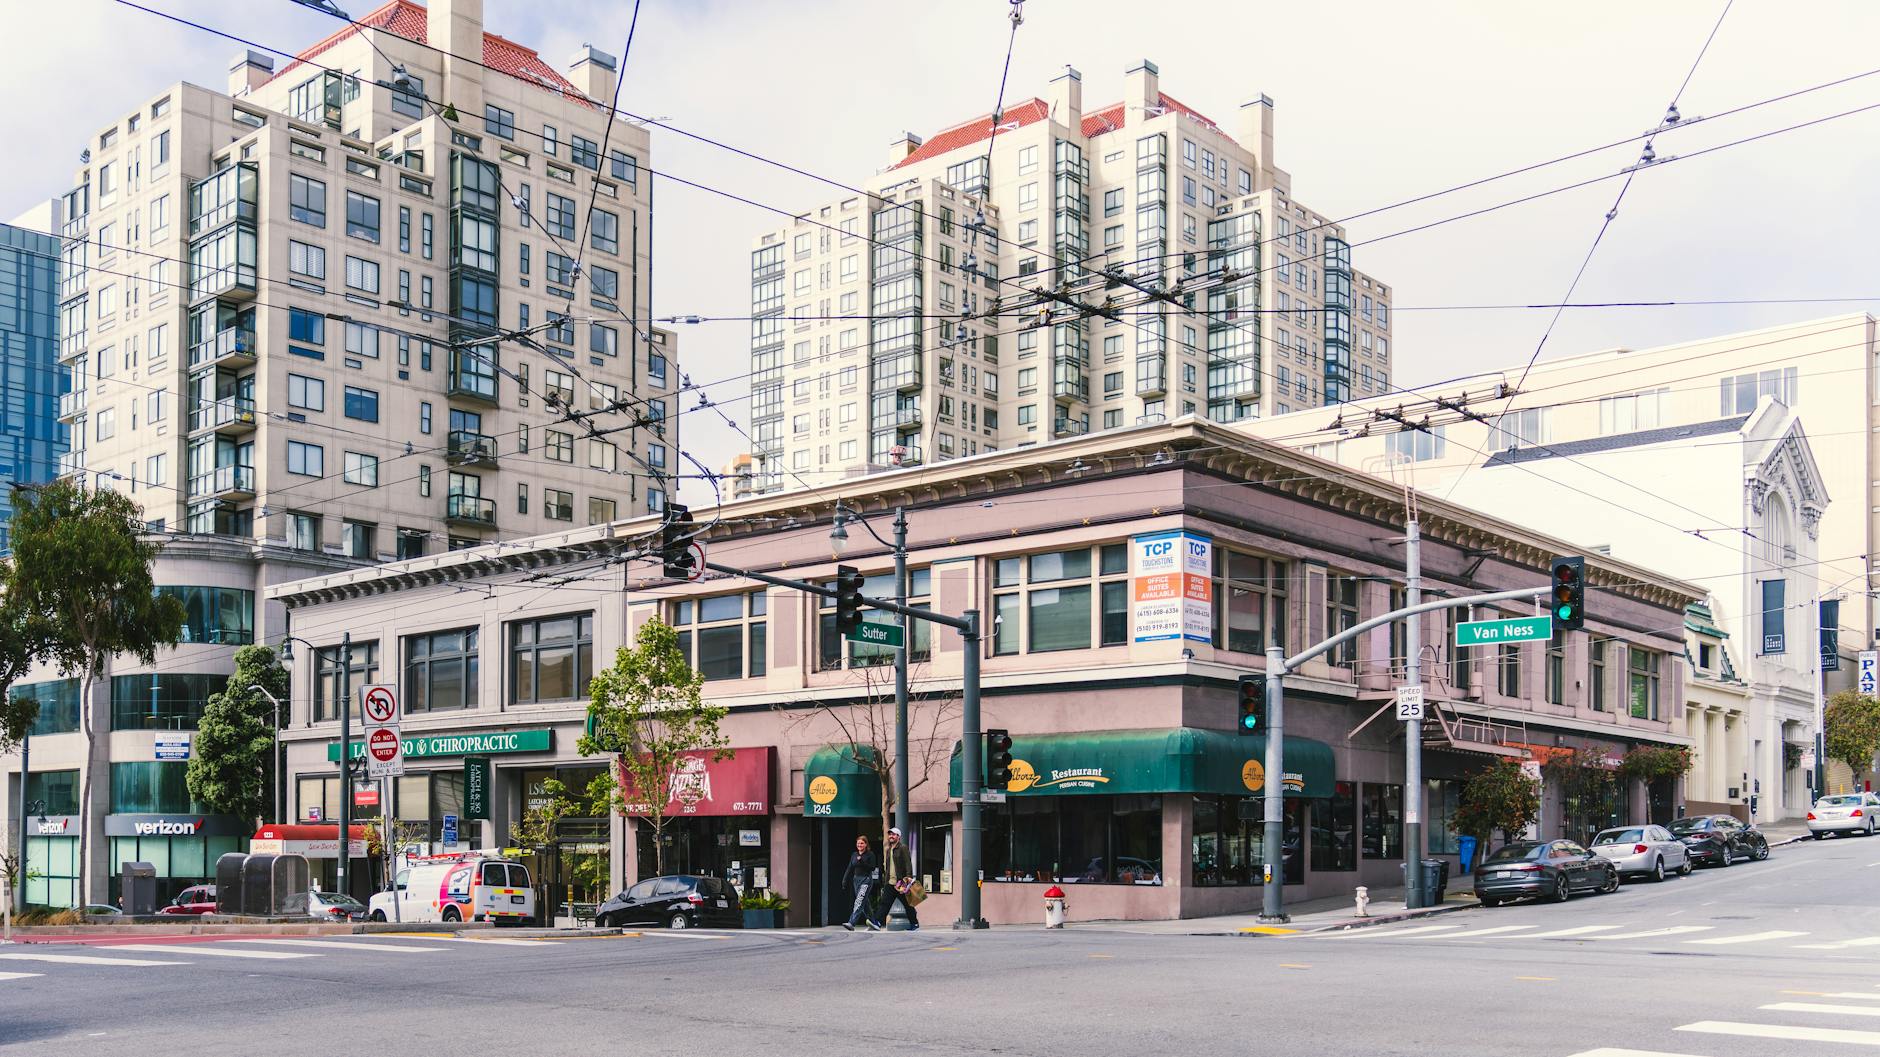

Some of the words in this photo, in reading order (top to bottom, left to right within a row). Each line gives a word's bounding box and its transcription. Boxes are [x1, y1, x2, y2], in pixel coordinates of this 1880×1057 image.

[1144, 541, 1172, 556] TCP
[1189, 542, 1206, 556] TCP
[1147, 576, 1168, 584] OFFICE
[1147, 583, 1168, 591] SUITES
[1141, 590, 1175, 599] AVAILABLE
[862, 626, 888, 640] Sutter
[1473, 627, 1498, 639] Van
[1504, 624, 1534, 637] Ness
[1401, 704, 1420, 716] 25
[431, 734, 518, 753] CHIROPRACTIC
[1051, 767, 1103, 780] Restaurant
[810, 783, 836, 795] Alborz
[1059, 781, 1078, 790] PERSIAN
[475, 793, 482, 801] &
[475, 802, 482, 814] SO
[733, 802, 763, 811] 673-7771
[813, 804, 832, 815] 1245
[37, 819, 64, 834] verizon
[134, 819, 195, 835] verizon
